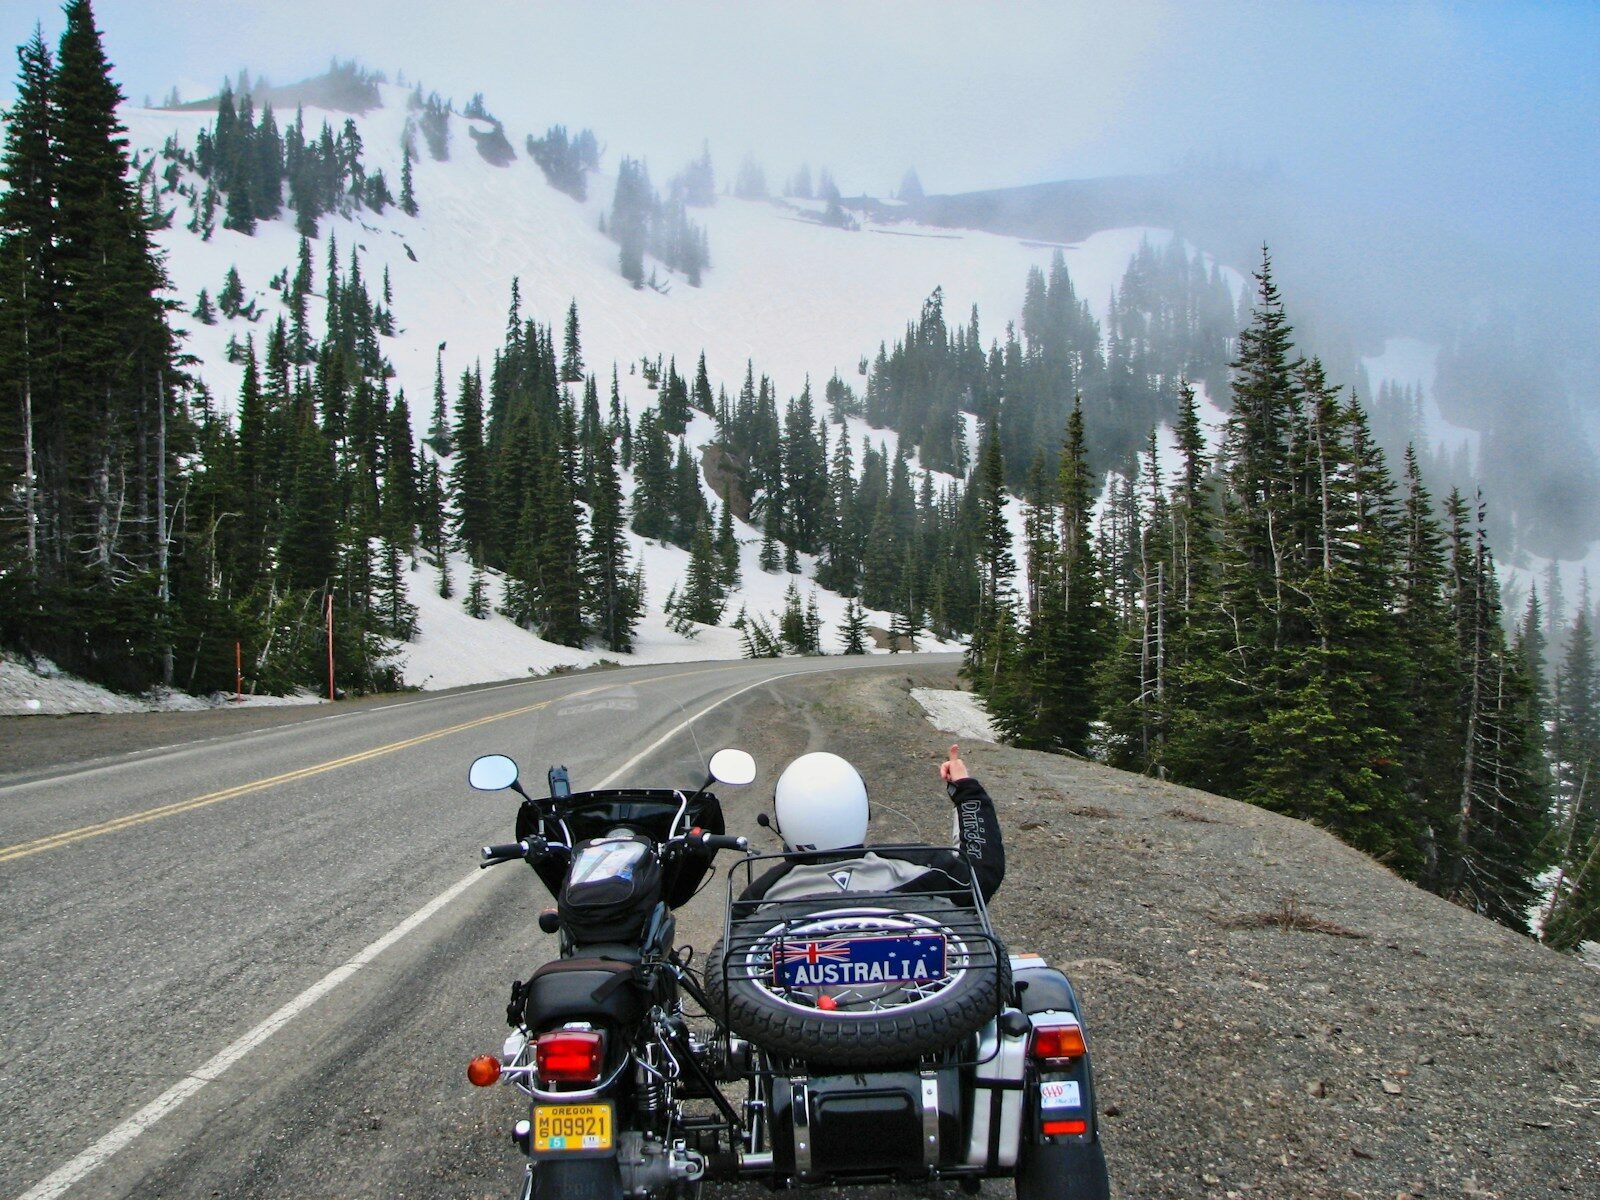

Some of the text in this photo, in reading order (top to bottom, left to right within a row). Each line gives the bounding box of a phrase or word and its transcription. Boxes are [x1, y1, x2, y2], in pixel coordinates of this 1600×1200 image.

[794, 958, 929, 985] AUSTRALIA
[551, 1107, 593, 1116] OREGON
[552, 1117, 604, 1137] 09921
